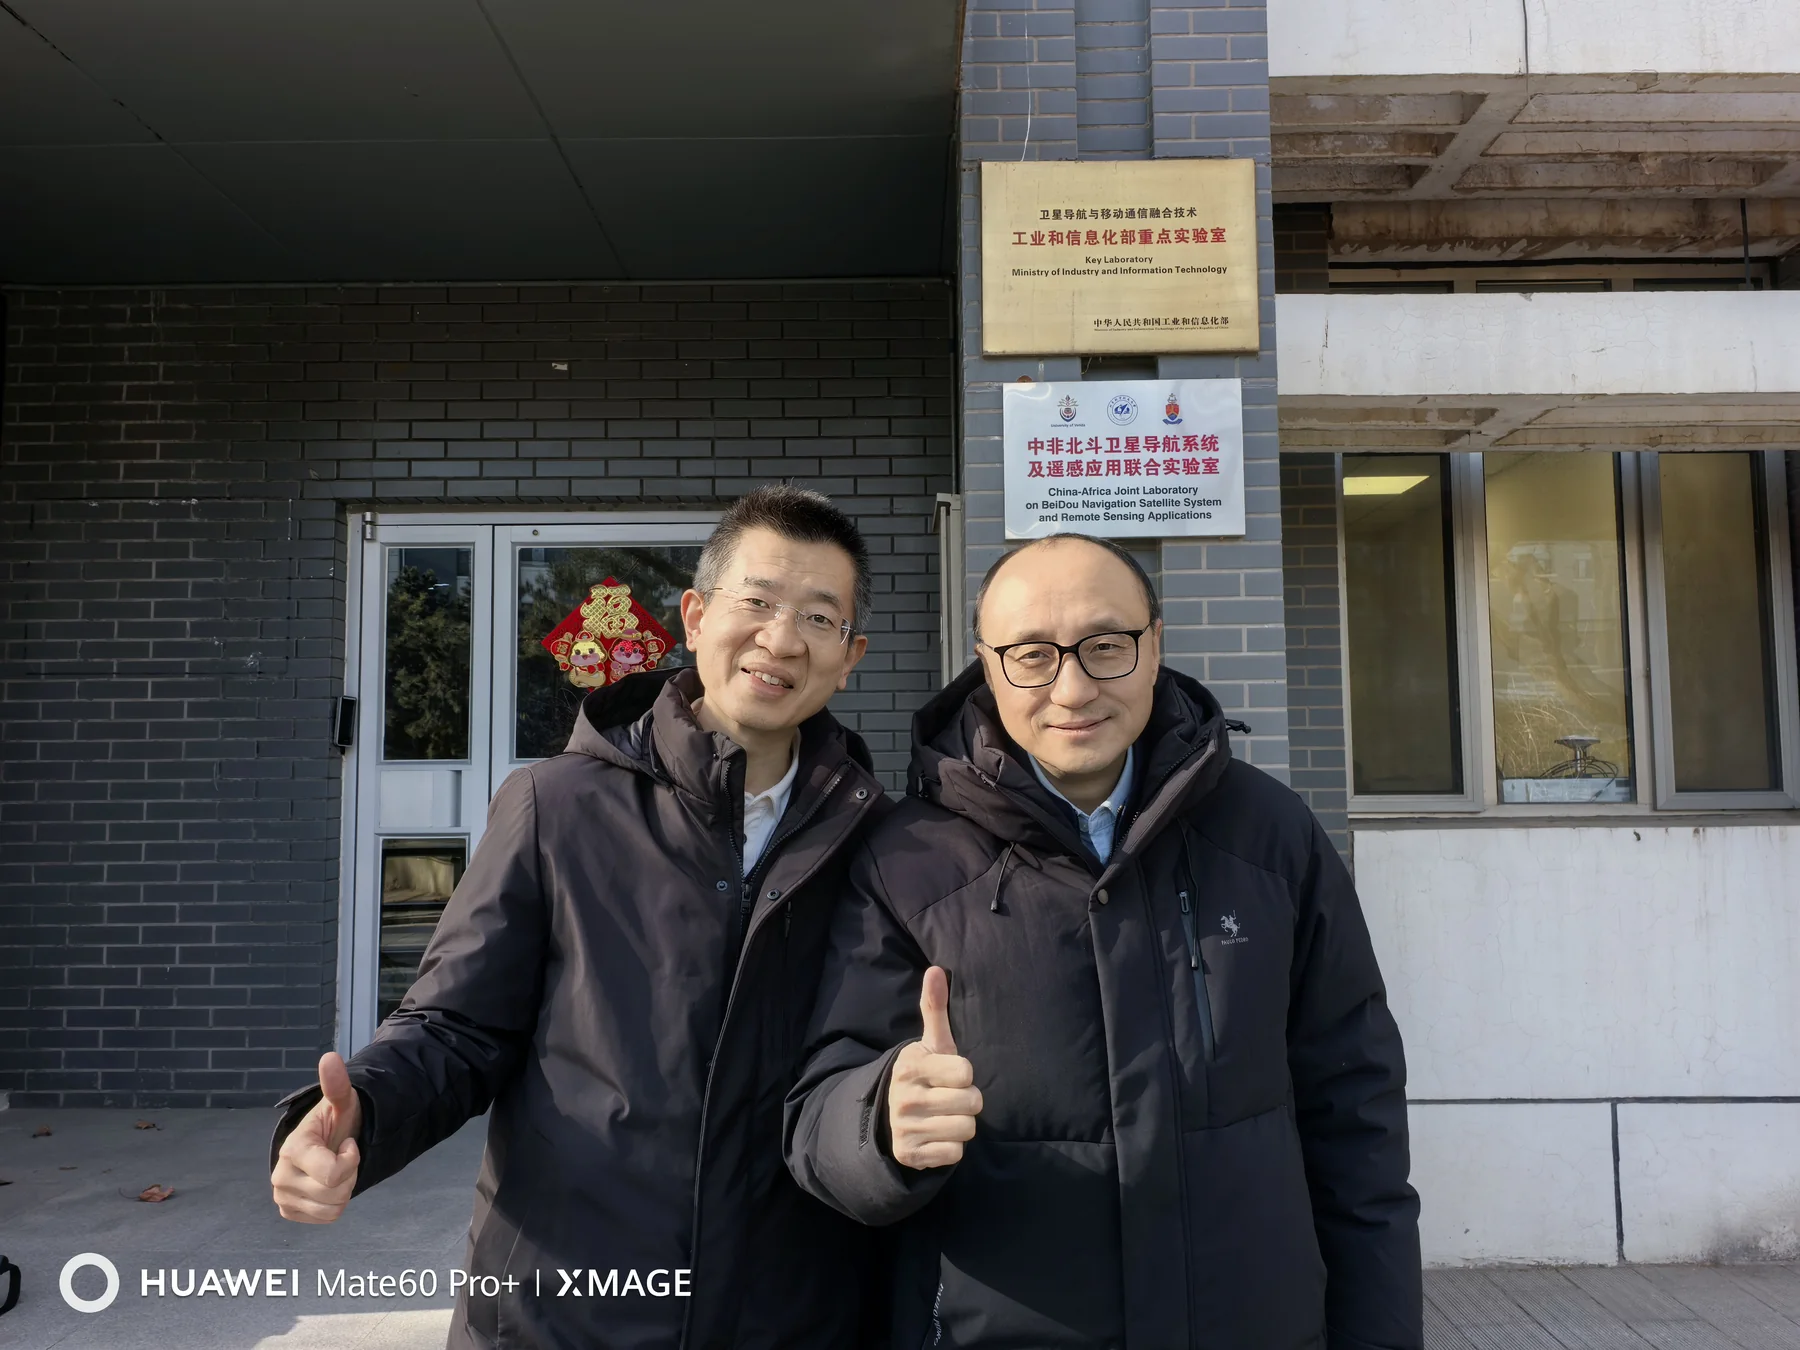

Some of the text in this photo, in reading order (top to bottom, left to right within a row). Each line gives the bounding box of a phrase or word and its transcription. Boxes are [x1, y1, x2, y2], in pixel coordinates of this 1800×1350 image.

[1039, 206, 1198, 221] 卫星导航与移动通信融合技术
[1011, 226, 1227, 247] 工业和信息化部重点实验室
[1085, 255, 1153, 265] Key Laboratory
[1011, 264, 1228, 278] Ministry of Industry and Information Technology
[1094, 316, 1229, 327] 中华人民共和国工业和信息化部
[1027, 434, 1220, 456] 中非北斗卫星导航系统
[1027, 457, 1220, 479] 及遥感应用联合实验室
[1048, 485, 1199, 497] China-Africa Joint Laboratory
[1025, 497, 1222, 511] on BeiDou Navigation Satellite System
[1038, 510, 1212, 523] and Remote Sensing Applications
[580, 584, 639, 639] 福
